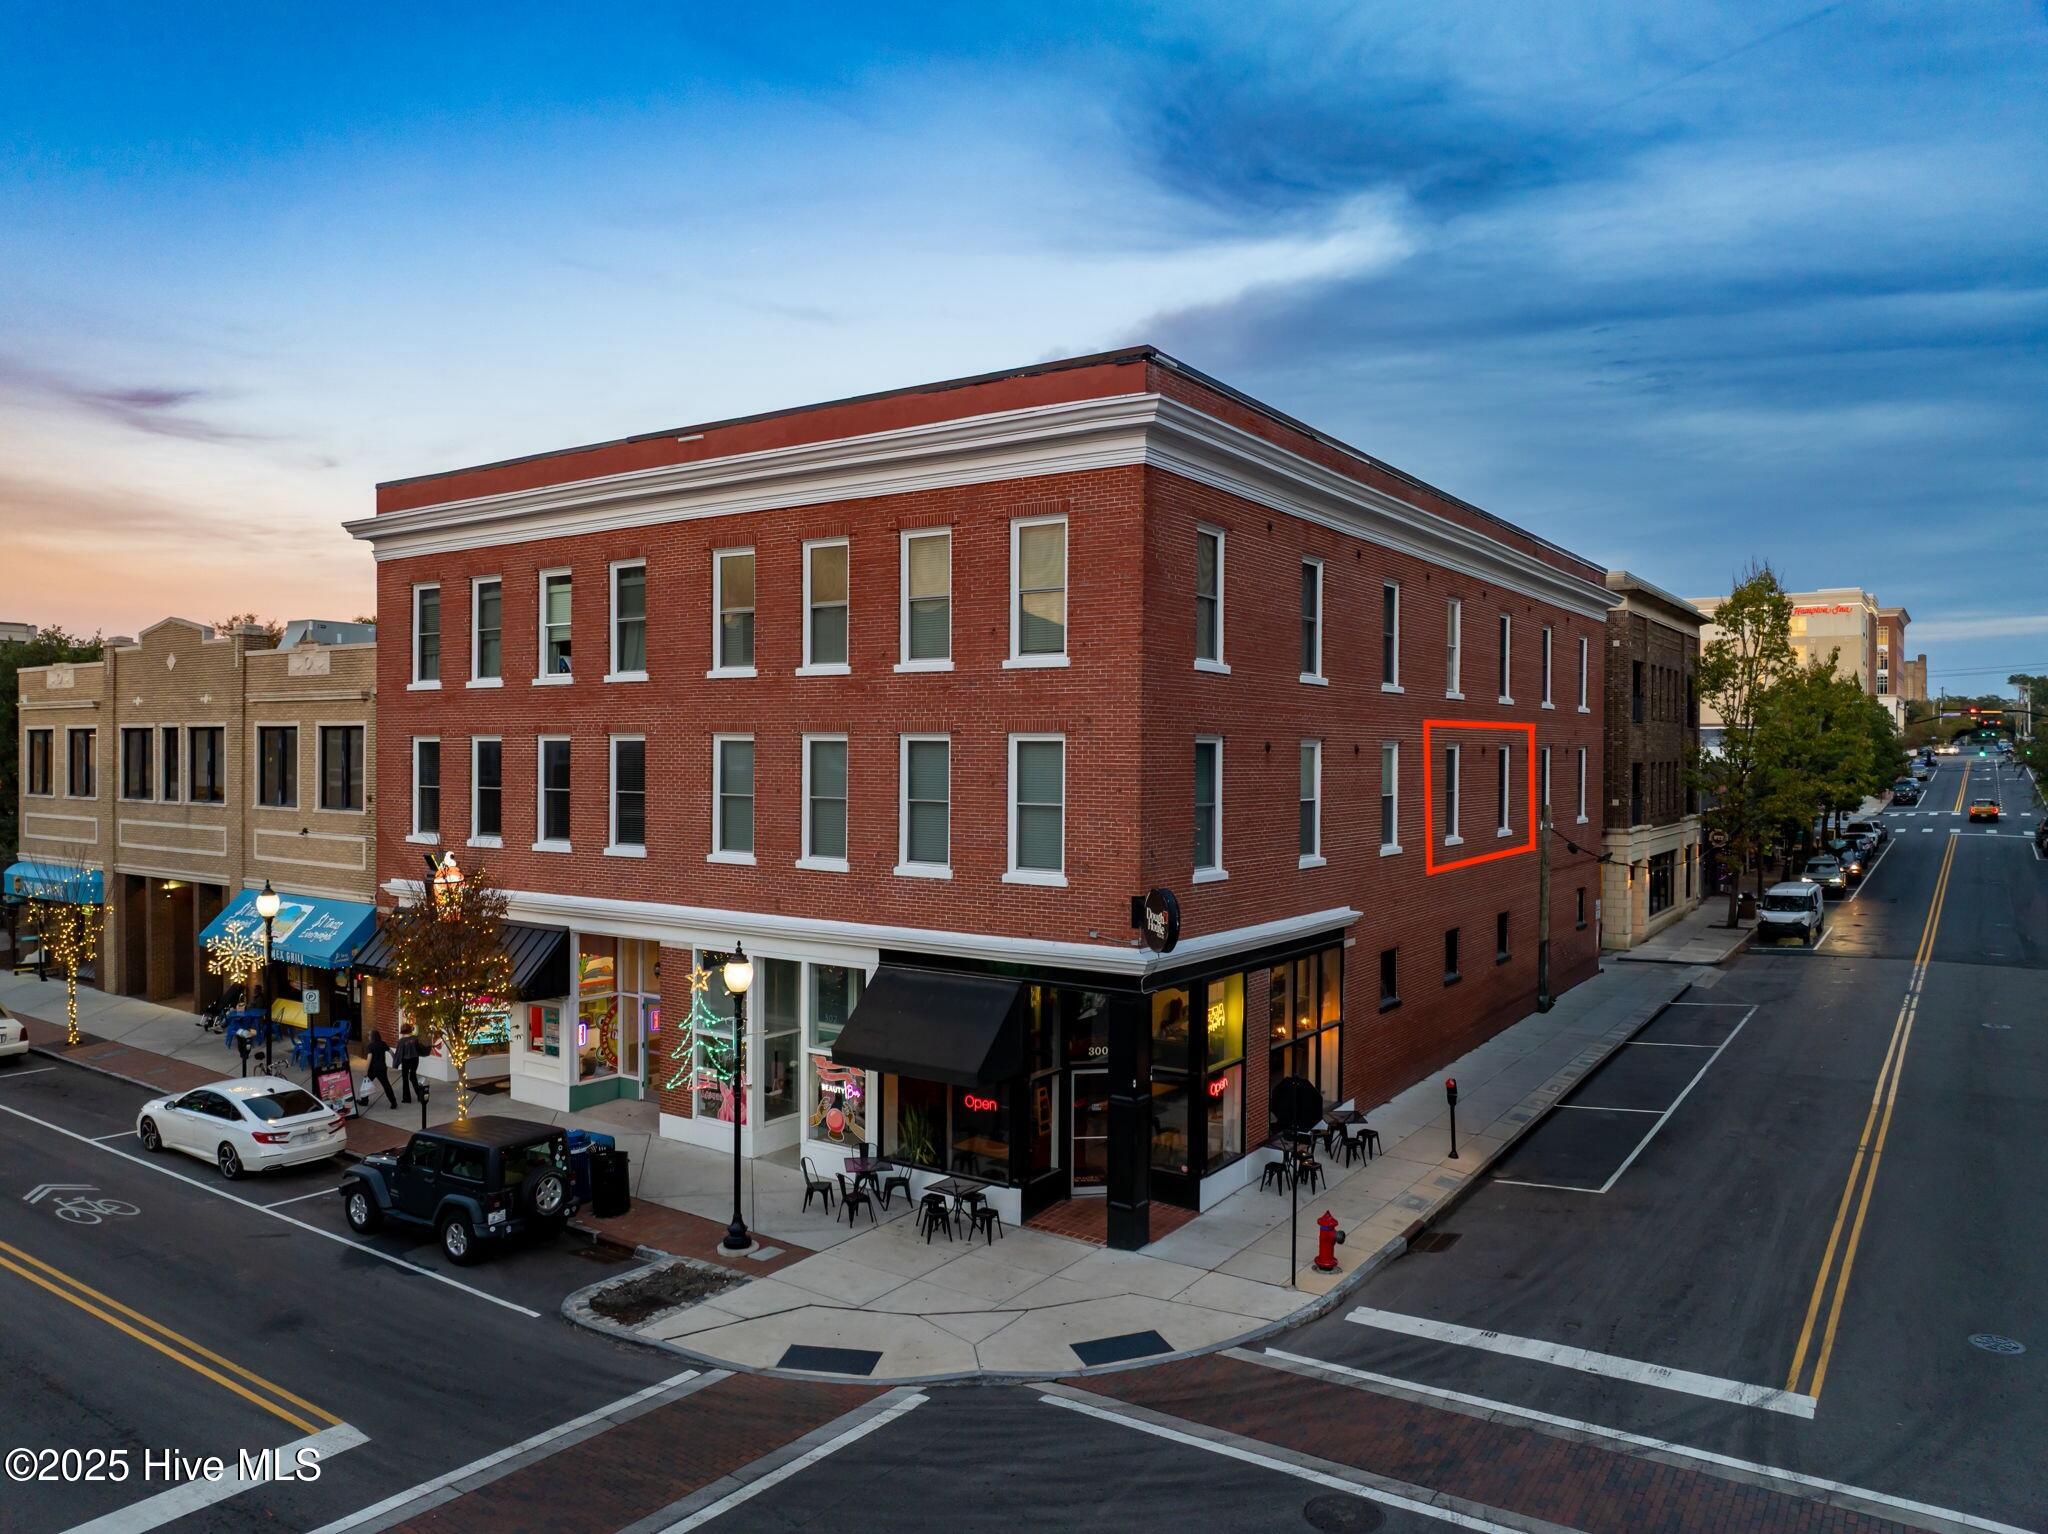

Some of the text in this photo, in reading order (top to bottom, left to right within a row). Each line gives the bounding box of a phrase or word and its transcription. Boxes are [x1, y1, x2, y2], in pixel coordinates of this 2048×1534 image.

[1793, 604, 1852, 615] Hampton Inn
[1146, 907, 1165, 924] Dough
[286, 951, 304, 965] GRILL
[1088, 1046, 1109, 1056] 300
[821, 1083, 845, 1095] BEAUTY
[1209, 1077, 1229, 1097] Open
[964, 1094, 997, 1112] Open
